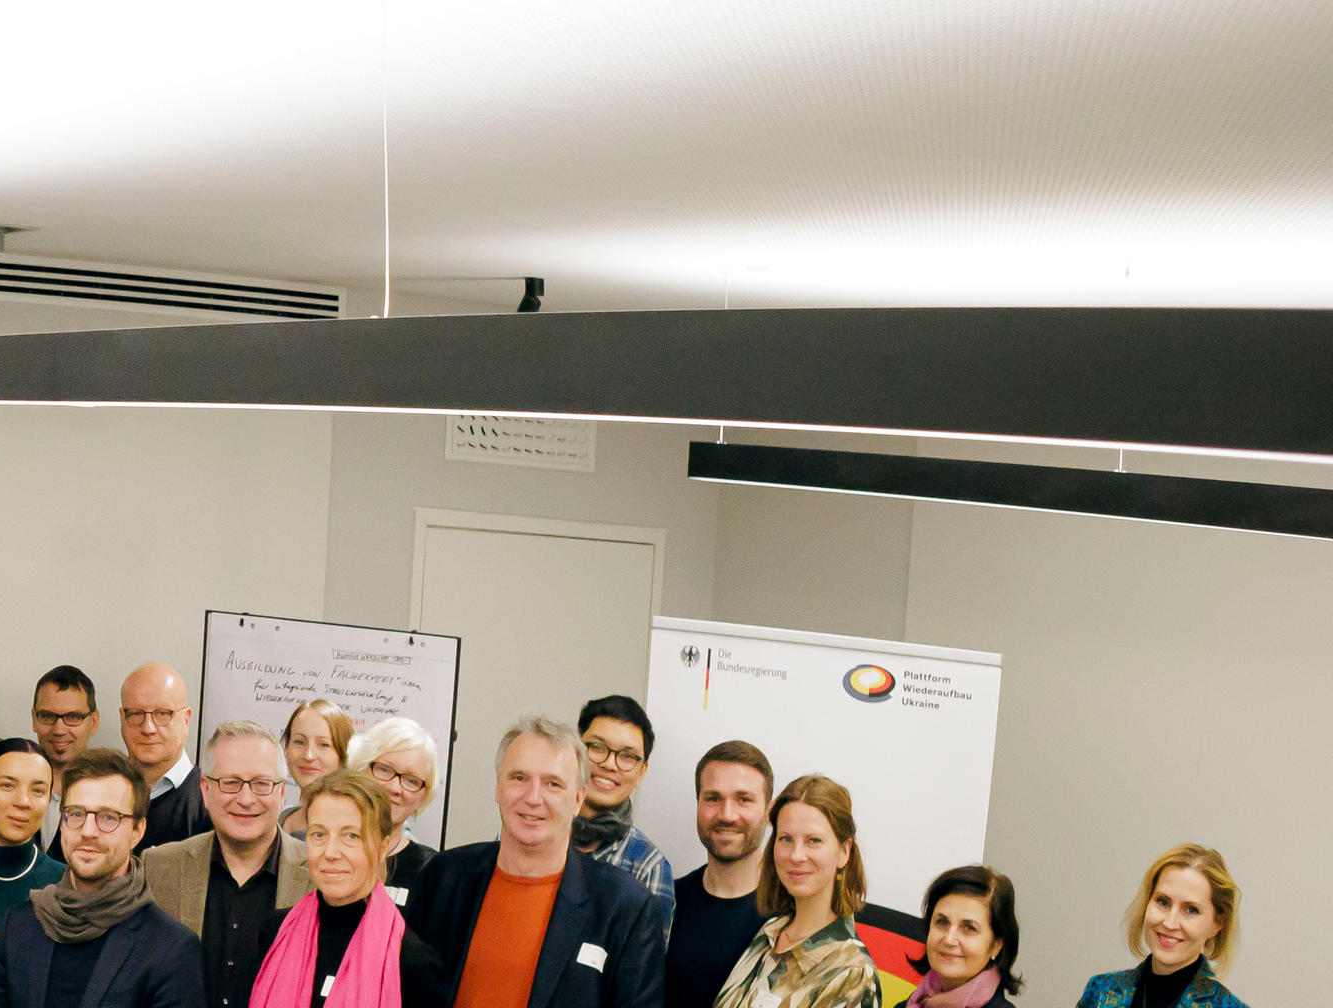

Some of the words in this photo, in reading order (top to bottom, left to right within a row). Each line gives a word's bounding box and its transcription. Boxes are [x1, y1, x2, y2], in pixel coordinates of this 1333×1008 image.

[718, 648, 733, 659] Die
[717, 662, 788, 679] Bundesregierung
[903, 670, 952, 684] Plattform
[902, 684, 973, 700] Wiederaufbau
[901, 698, 941, 710] Ukraine
